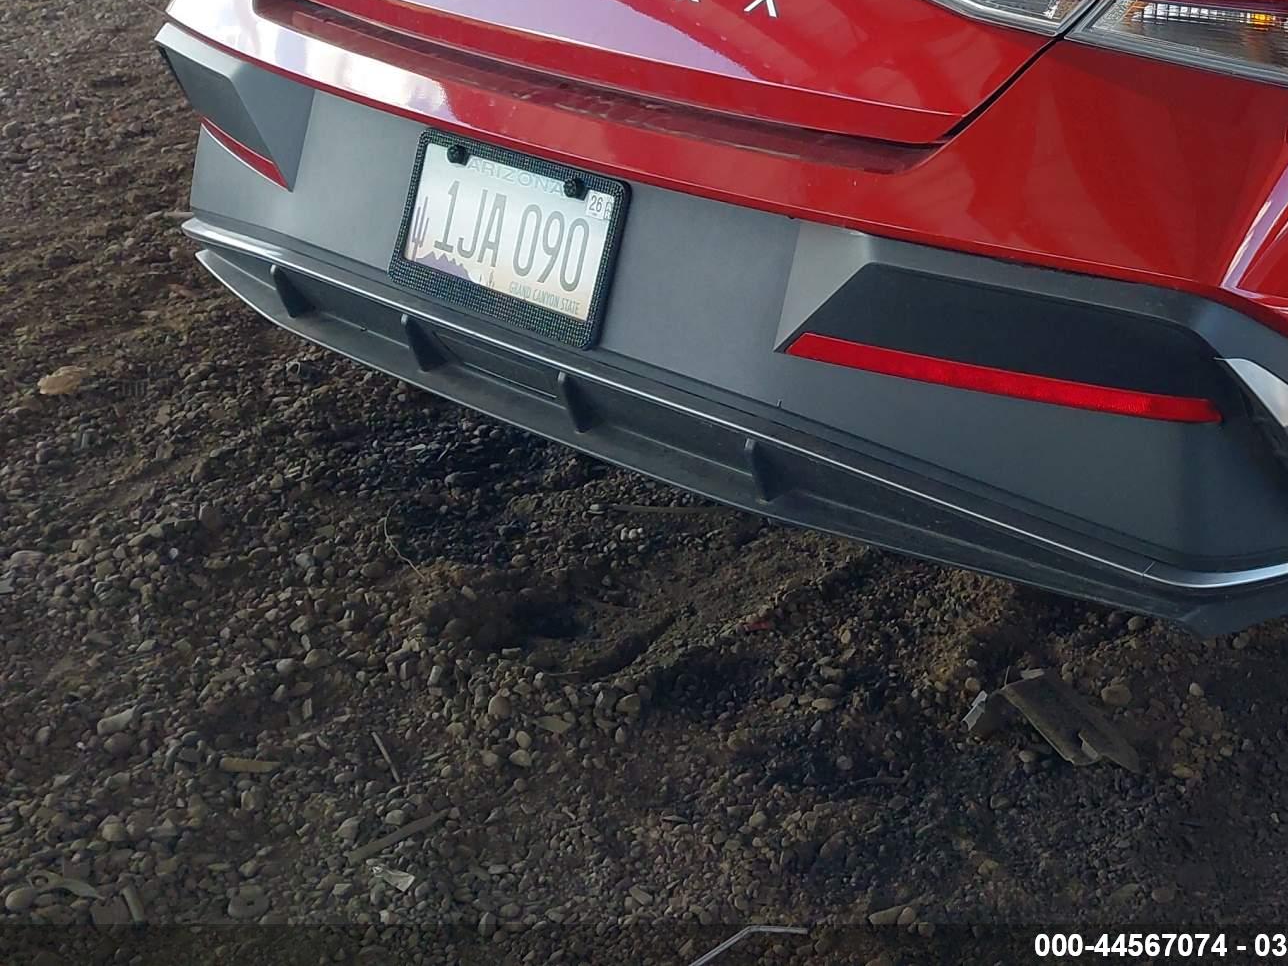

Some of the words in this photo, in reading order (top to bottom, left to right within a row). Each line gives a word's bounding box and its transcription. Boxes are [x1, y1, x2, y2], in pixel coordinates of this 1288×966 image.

[467, 157, 564, 197] ARIZONA
[589, 194, 604, 213] 26
[434, 180, 508, 267] 1JA
[512, 204, 590, 292] 090
[509, 280, 531, 299] GRAND
[532, 288, 560, 308] CANYON
[560, 296, 580, 315] STATE
